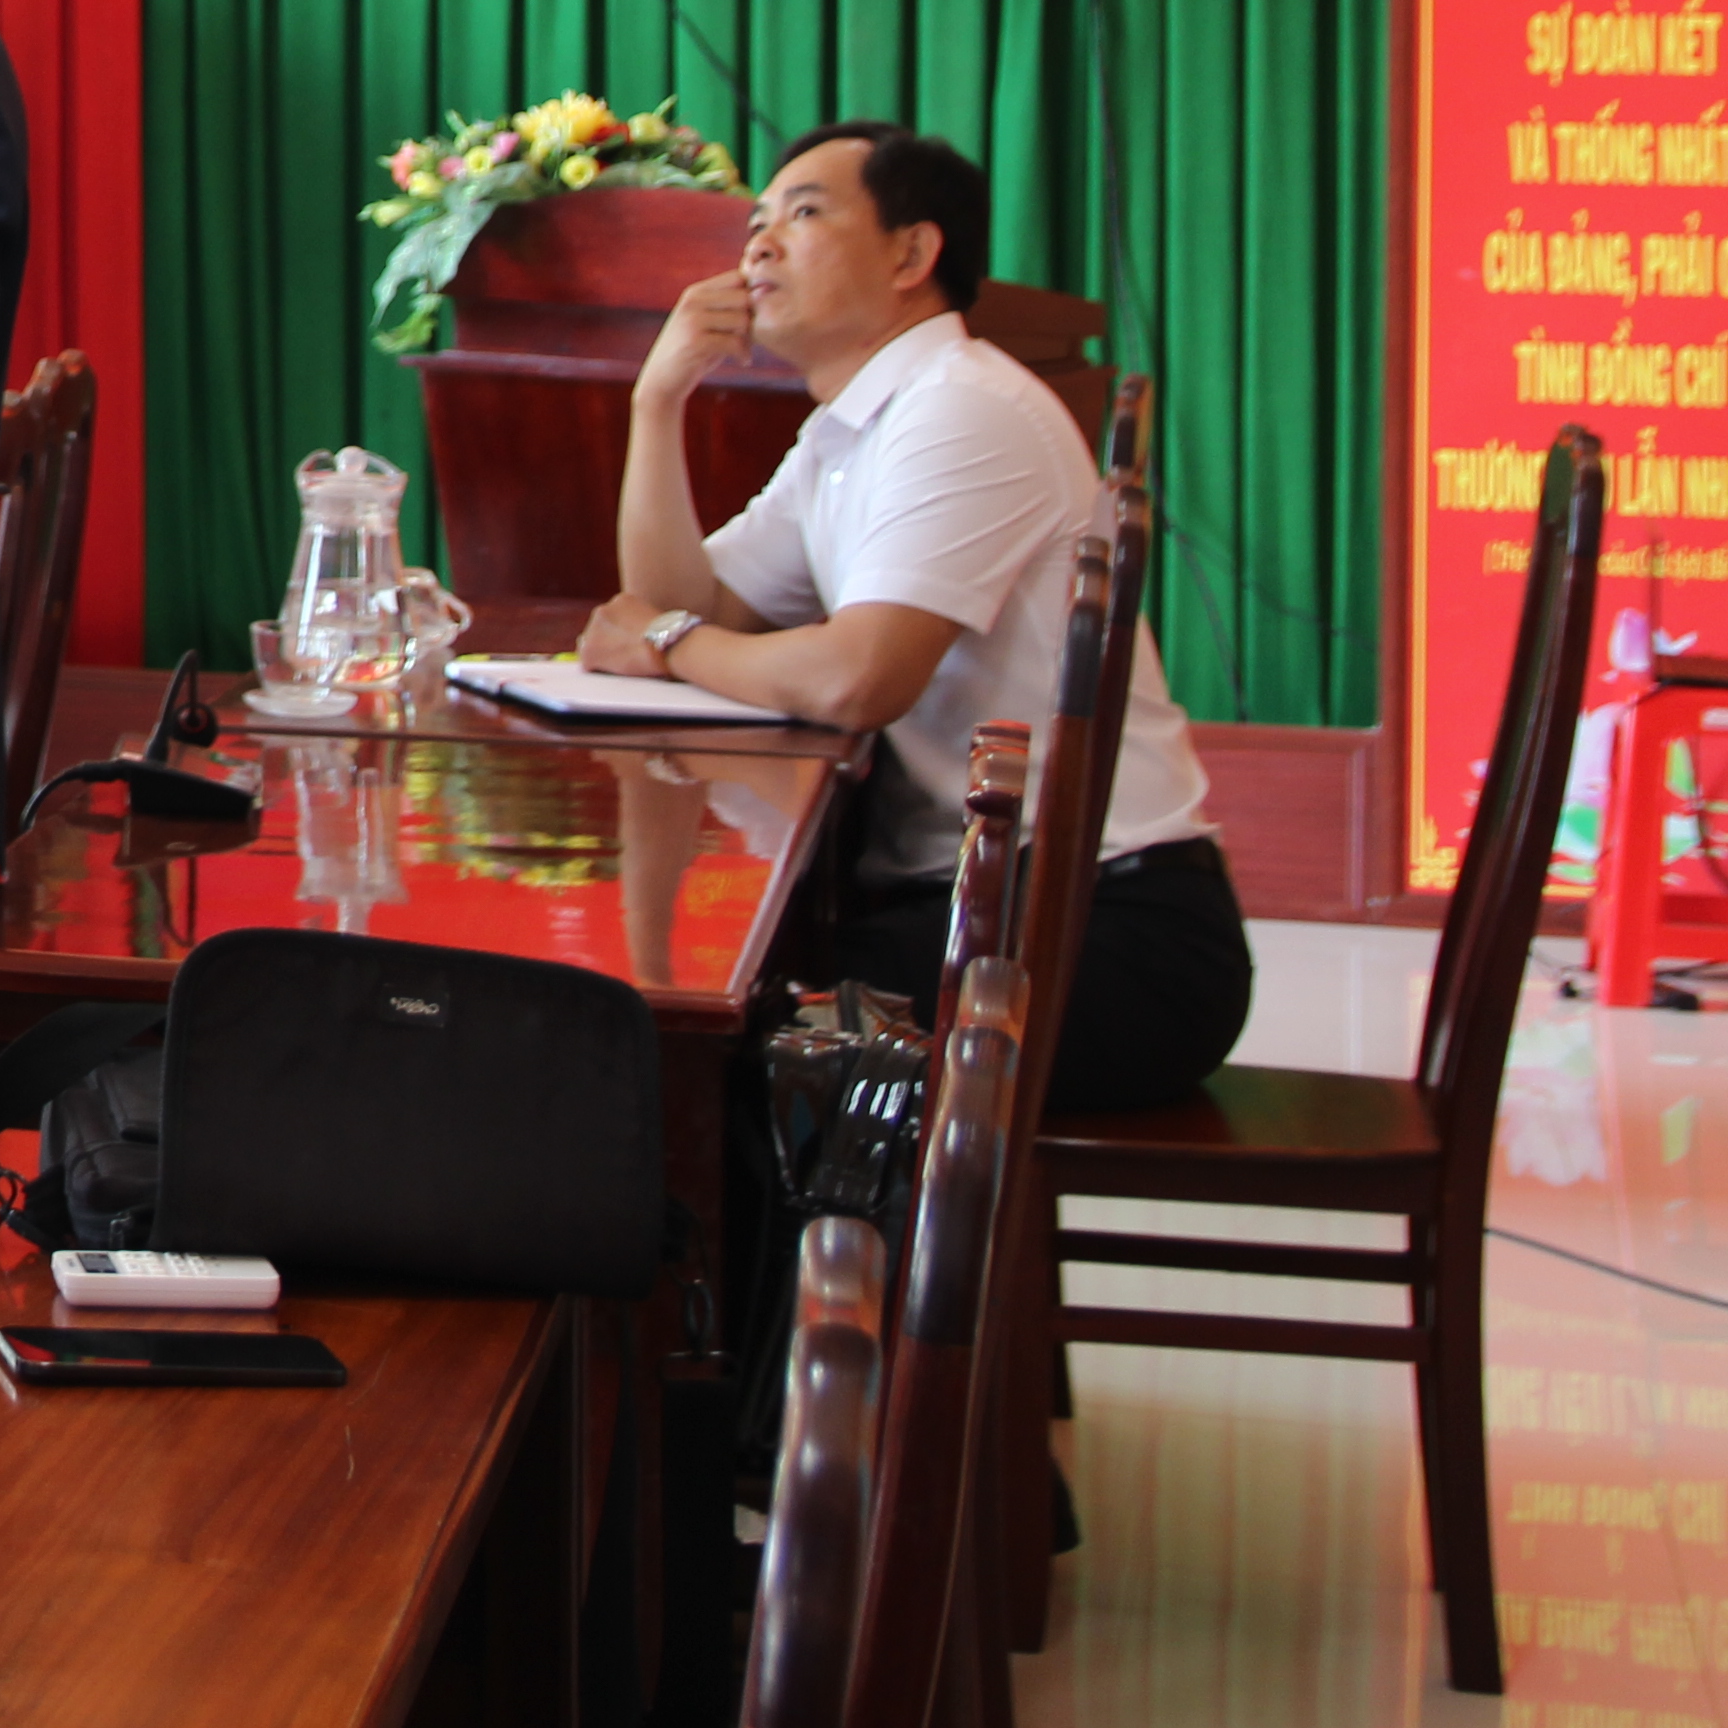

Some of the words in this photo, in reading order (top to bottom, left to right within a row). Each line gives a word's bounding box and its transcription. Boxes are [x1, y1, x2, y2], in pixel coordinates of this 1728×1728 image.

[1525, 0, 1574, 88] SỰ
[1507, 105, 1550, 185] VÀ
[1482, 206, 1543, 294] CỦA
